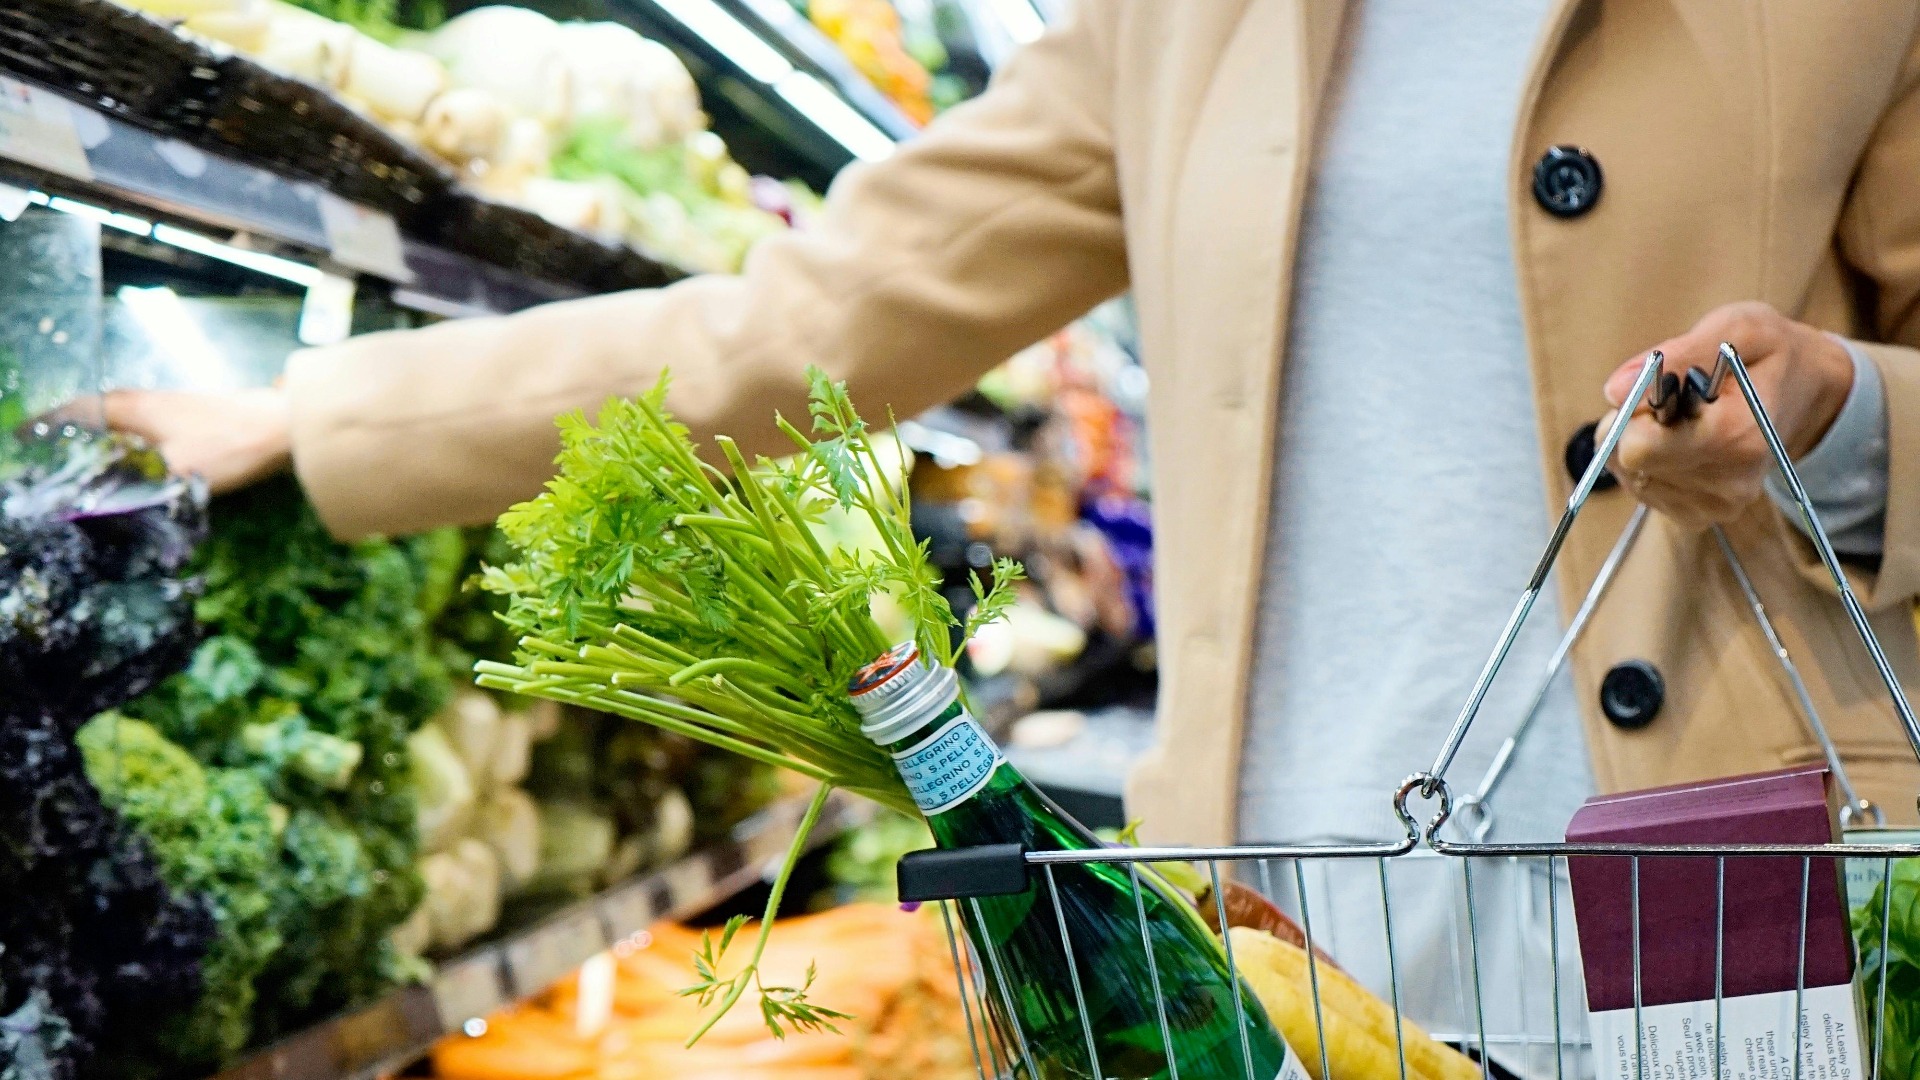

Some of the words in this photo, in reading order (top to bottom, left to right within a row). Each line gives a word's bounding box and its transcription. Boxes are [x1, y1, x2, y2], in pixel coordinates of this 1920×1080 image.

[1682, 1017, 1693, 1039] Seul
[1704, 1022, 1714, 1035] de
[1822, 1013, 1835, 1055] delicious
[1835, 1021, 1844, 1032] At
[1617, 1034, 1626, 1057] vous
[1648, 1025, 1660, 1068] Délicieux
[1685, 1041, 1692, 1054] un
[1695, 1031, 1704, 1054] avec
[1755, 1037, 1765, 1052] but
[1765, 1031, 1775, 1057] these
[1804, 1042, 1814, 1050] &
[1837, 1034, 1848, 1066] Lesley
[1641, 1044, 1651, 1080] accomp
[1744, 1037, 1755, 1072] cheese
[1780, 1056, 1789, 1064] A
[1805, 1052, 1814, 1068] her
[1620, 1059, 1628, 1072] ne
[1758, 1054, 1769, 1080] really
[1769, 1059, 1780, 1080] uniq
[1808, 1070, 1816, 1080] te
[1818, 1064, 1827, 1080] are
